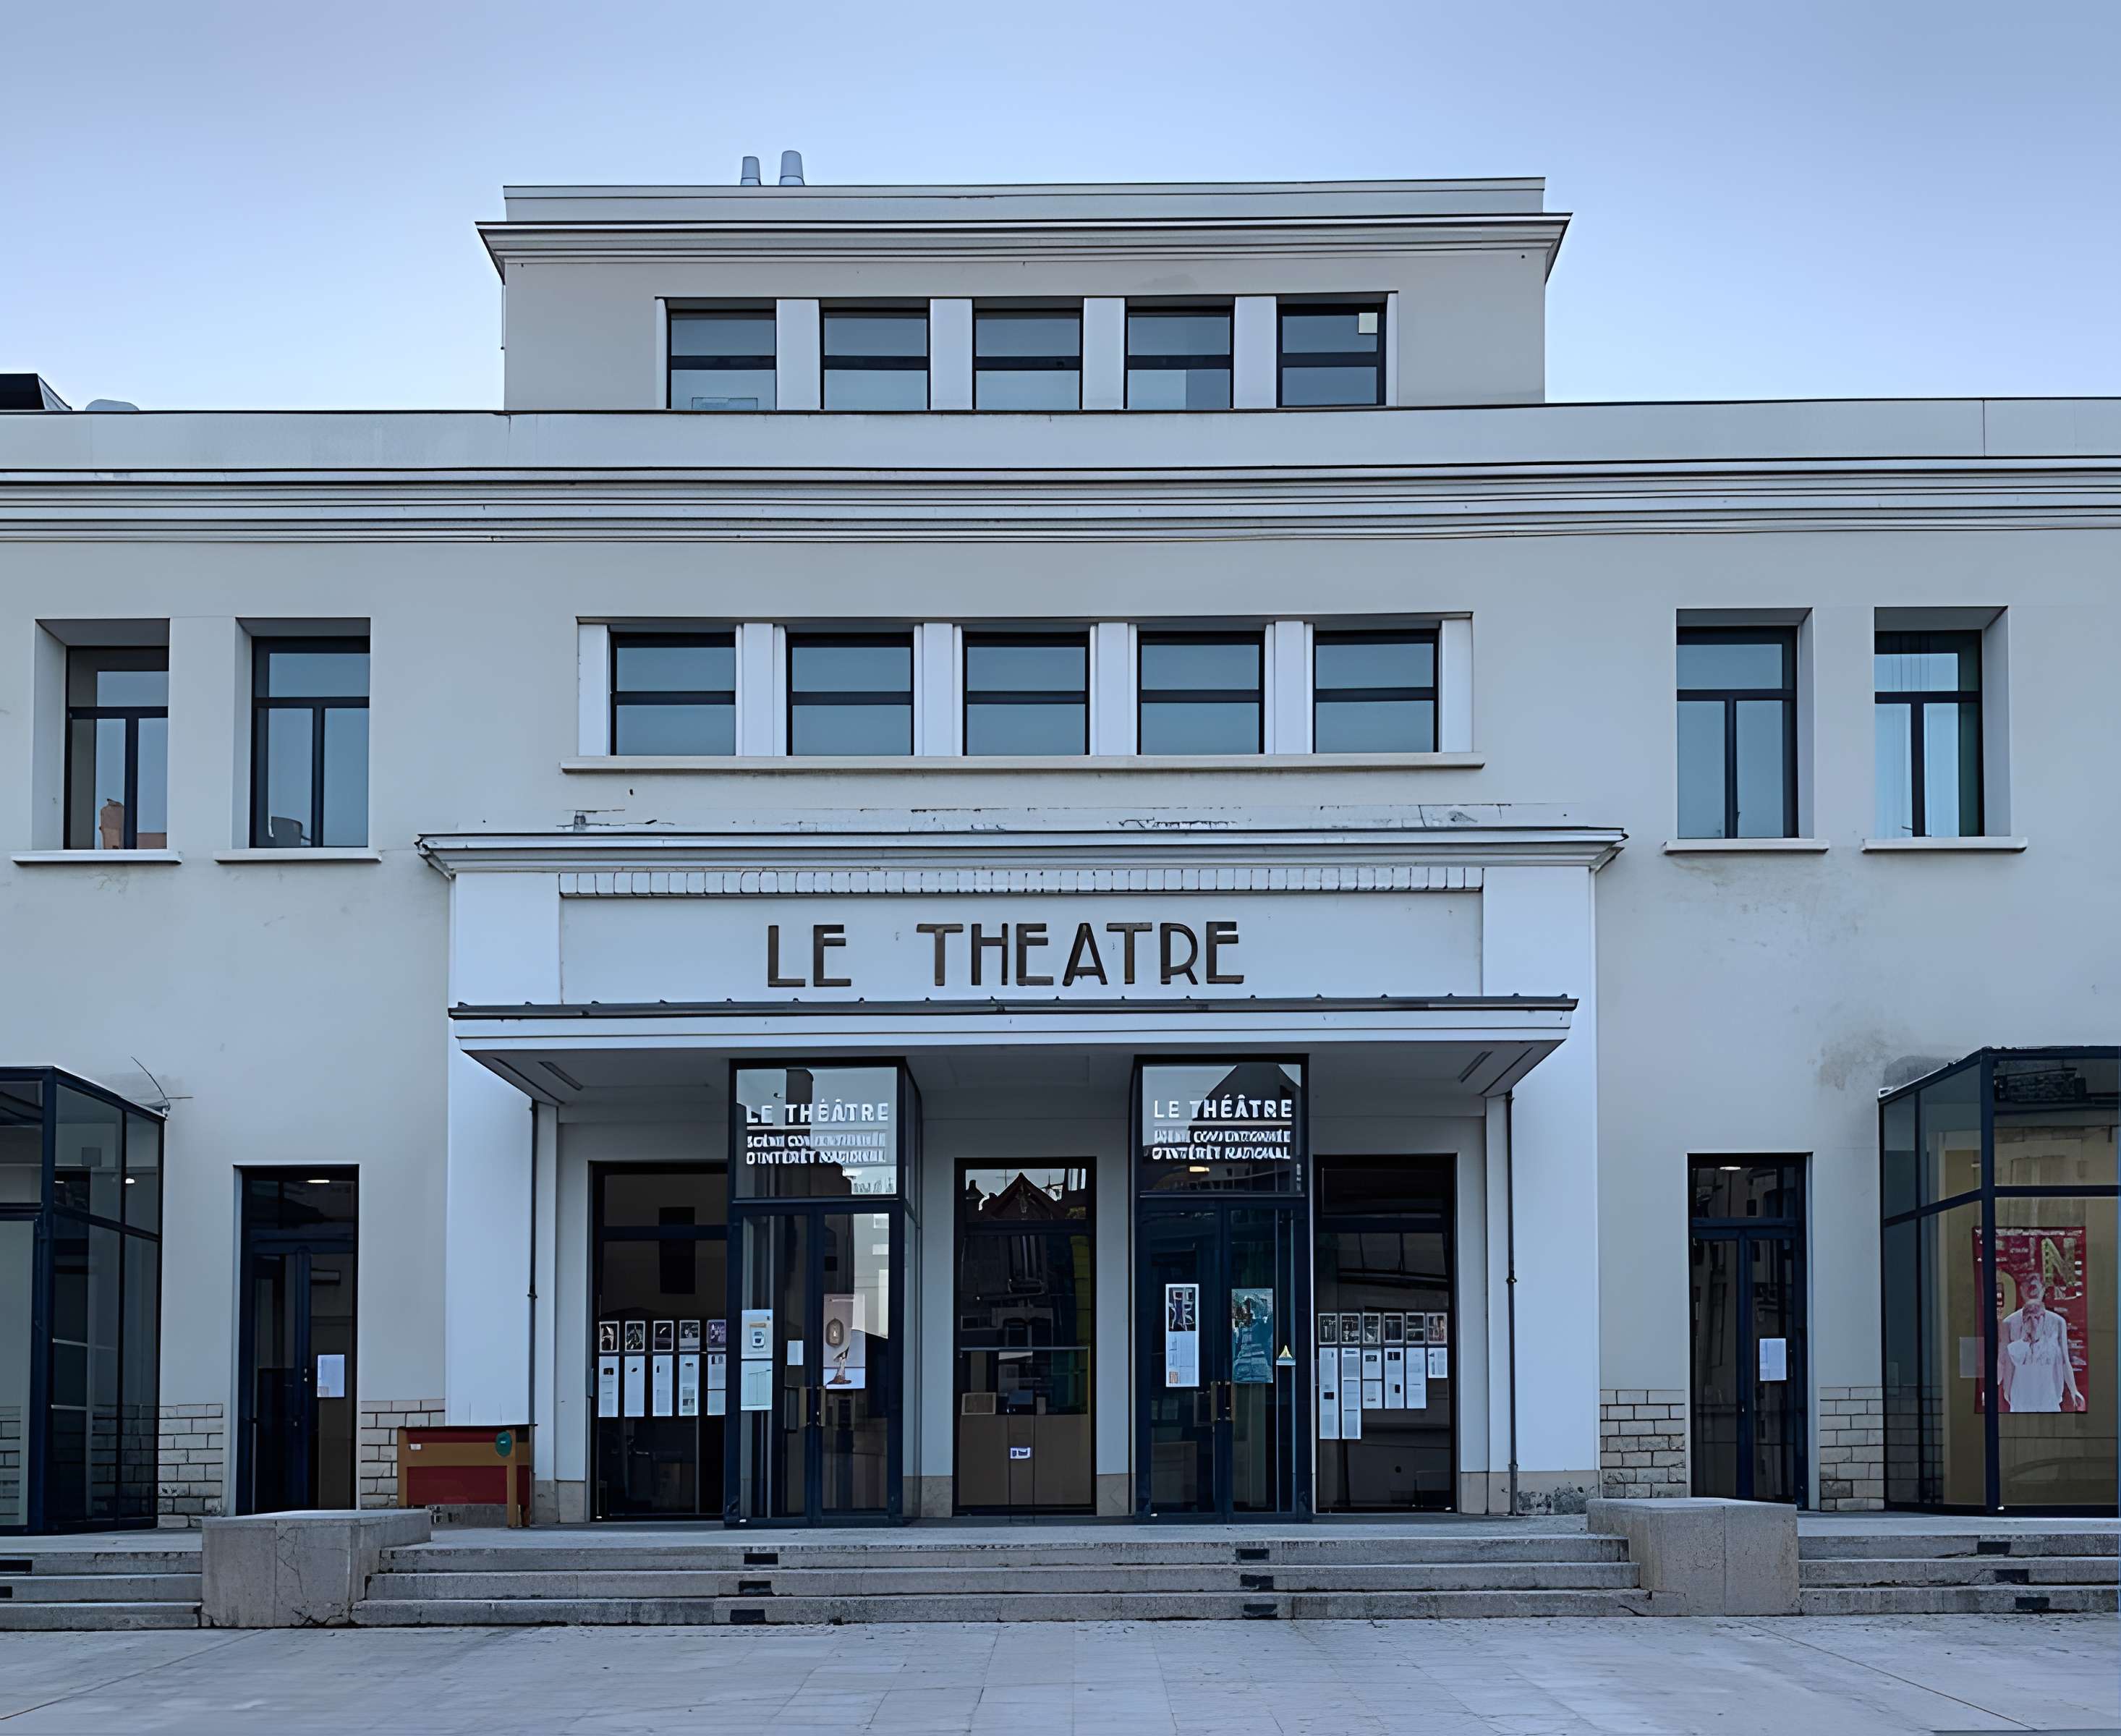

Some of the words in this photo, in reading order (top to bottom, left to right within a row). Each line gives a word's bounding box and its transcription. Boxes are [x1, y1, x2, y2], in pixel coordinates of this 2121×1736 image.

[768, 924, 851, 987] LE
[916, 921, 1245, 987] THEATRE
[746, 1105, 773, 1123] LE
[785, 1098, 888, 1123] THÉÂTRE
[1154, 1099, 1180, 1118] LE
[1189, 1094, 1293, 1118] THÉÂTRE
